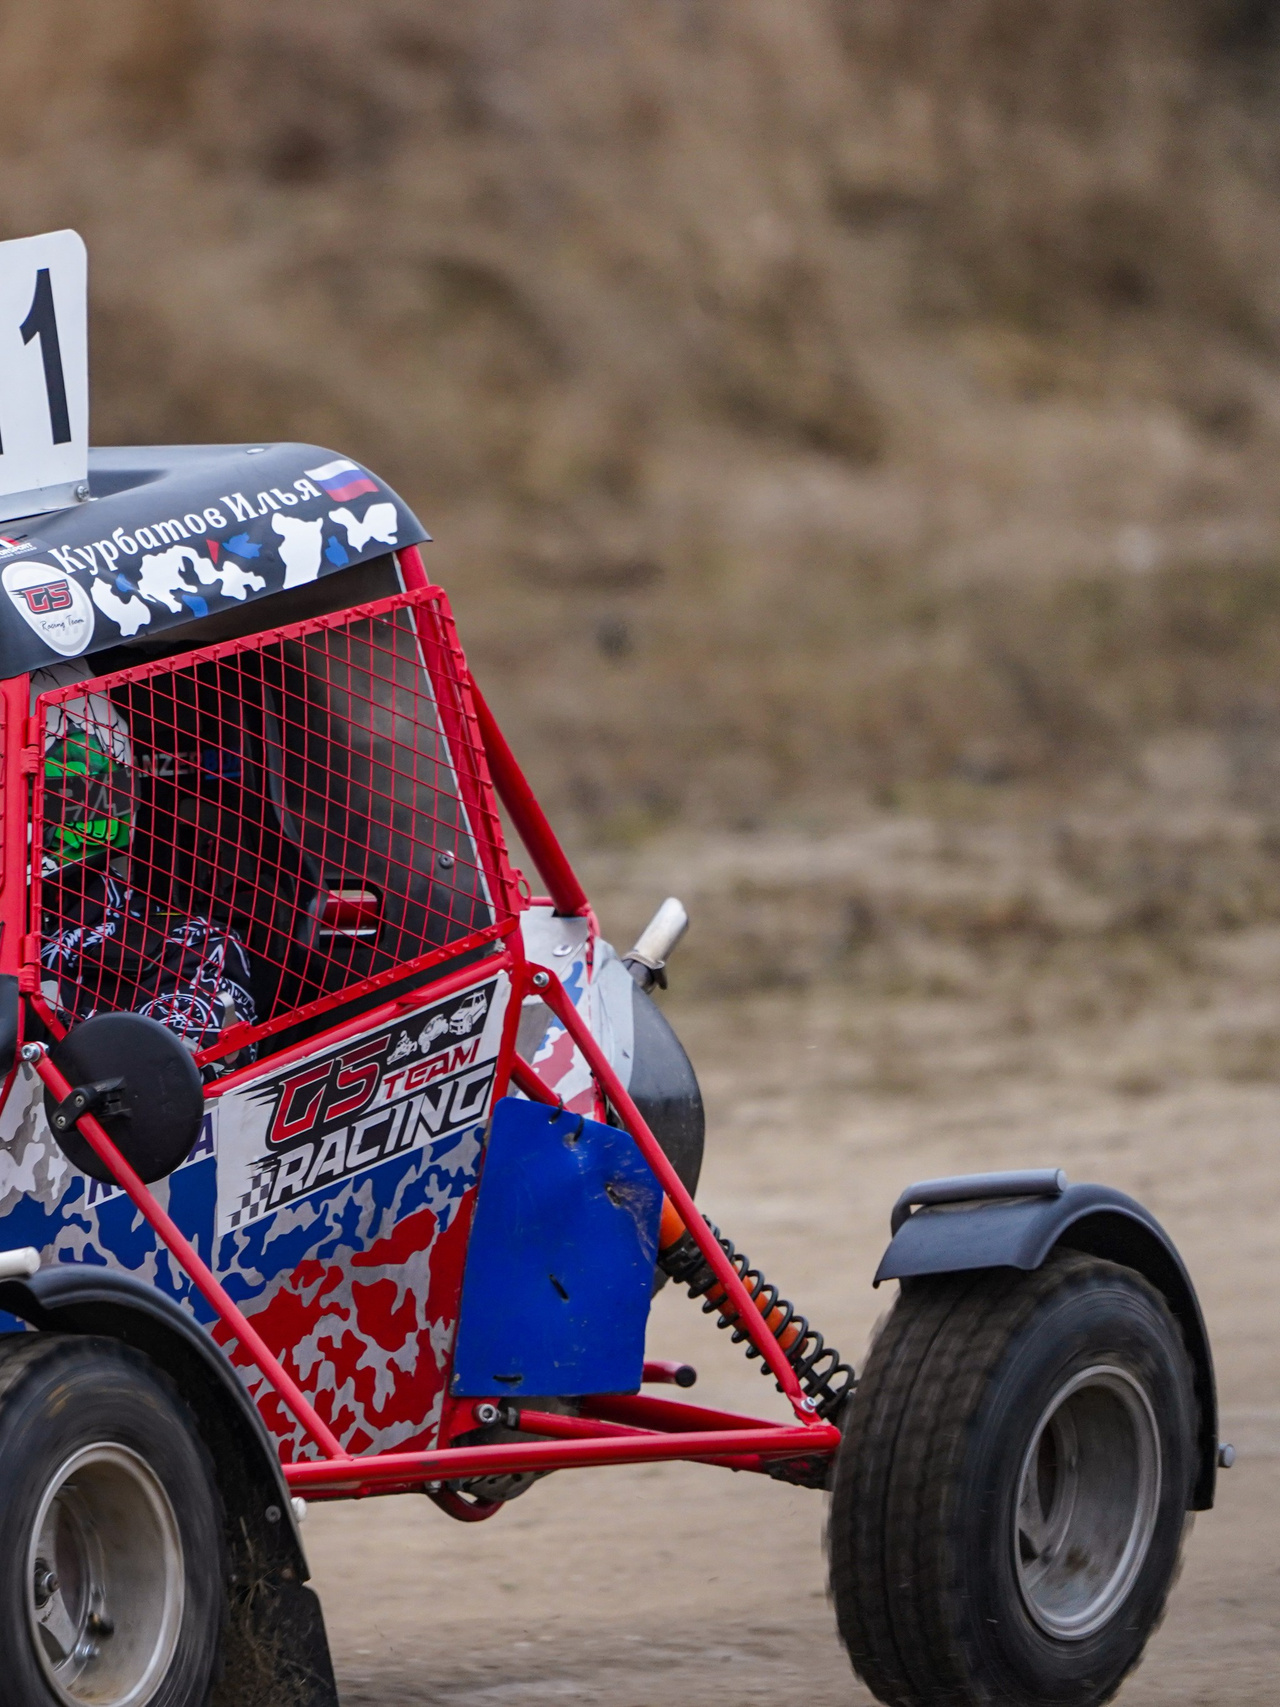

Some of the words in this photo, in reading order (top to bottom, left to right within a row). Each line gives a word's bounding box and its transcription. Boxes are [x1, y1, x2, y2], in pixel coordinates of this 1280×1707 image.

[48, 507, 228, 576] Курбатов
[219, 478, 322, 523] Илья
[23, 578, 74, 615] GS
[40, 619, 66, 632] Racing
[67, 614, 85, 627] Team
[269, 1033, 392, 1145] GS
[382, 1035, 481, 1101] TEAM
[269, 1062, 496, 1206] RACING
